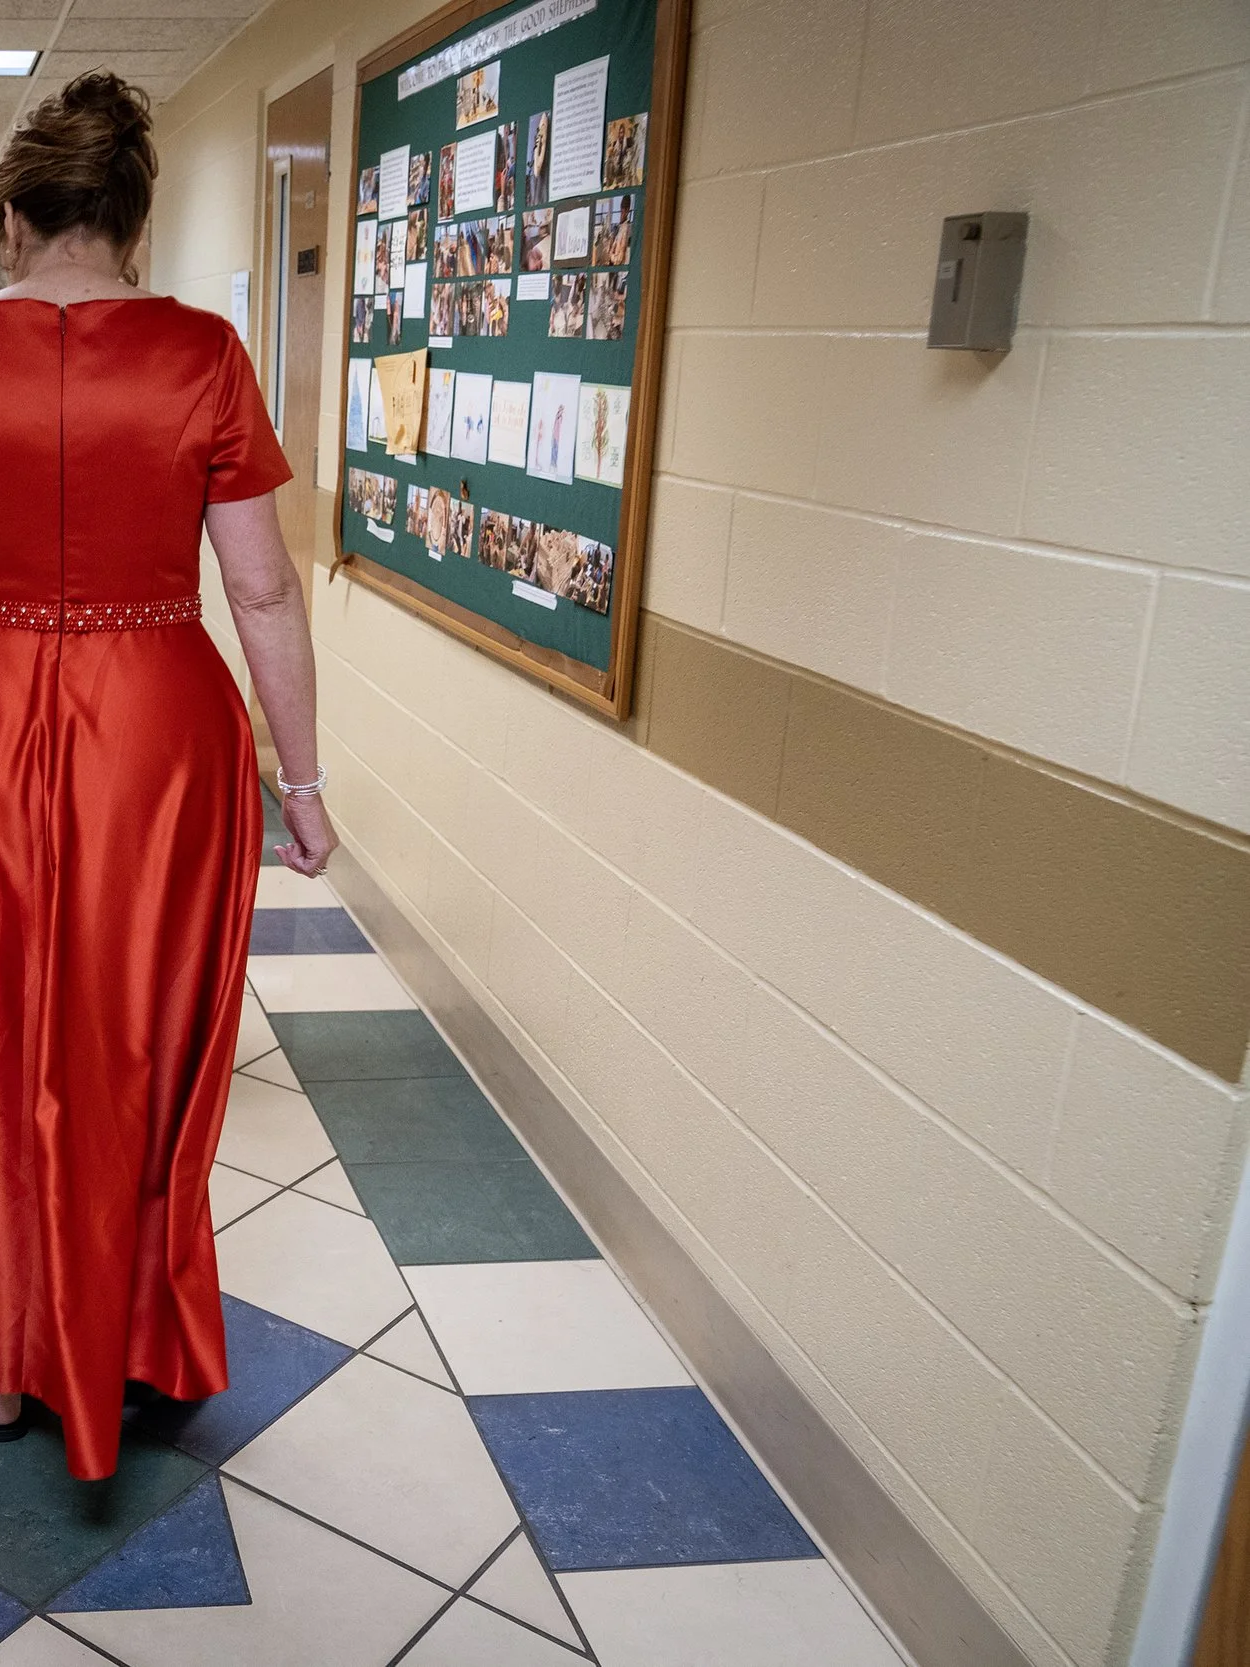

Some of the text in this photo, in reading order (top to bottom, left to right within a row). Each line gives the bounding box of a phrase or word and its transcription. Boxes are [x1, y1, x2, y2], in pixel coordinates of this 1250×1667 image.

[504, 21, 516, 41] THE
[520, 7, 546, 33] GOOD
[548, 0, 590, 20] SHEPHE
